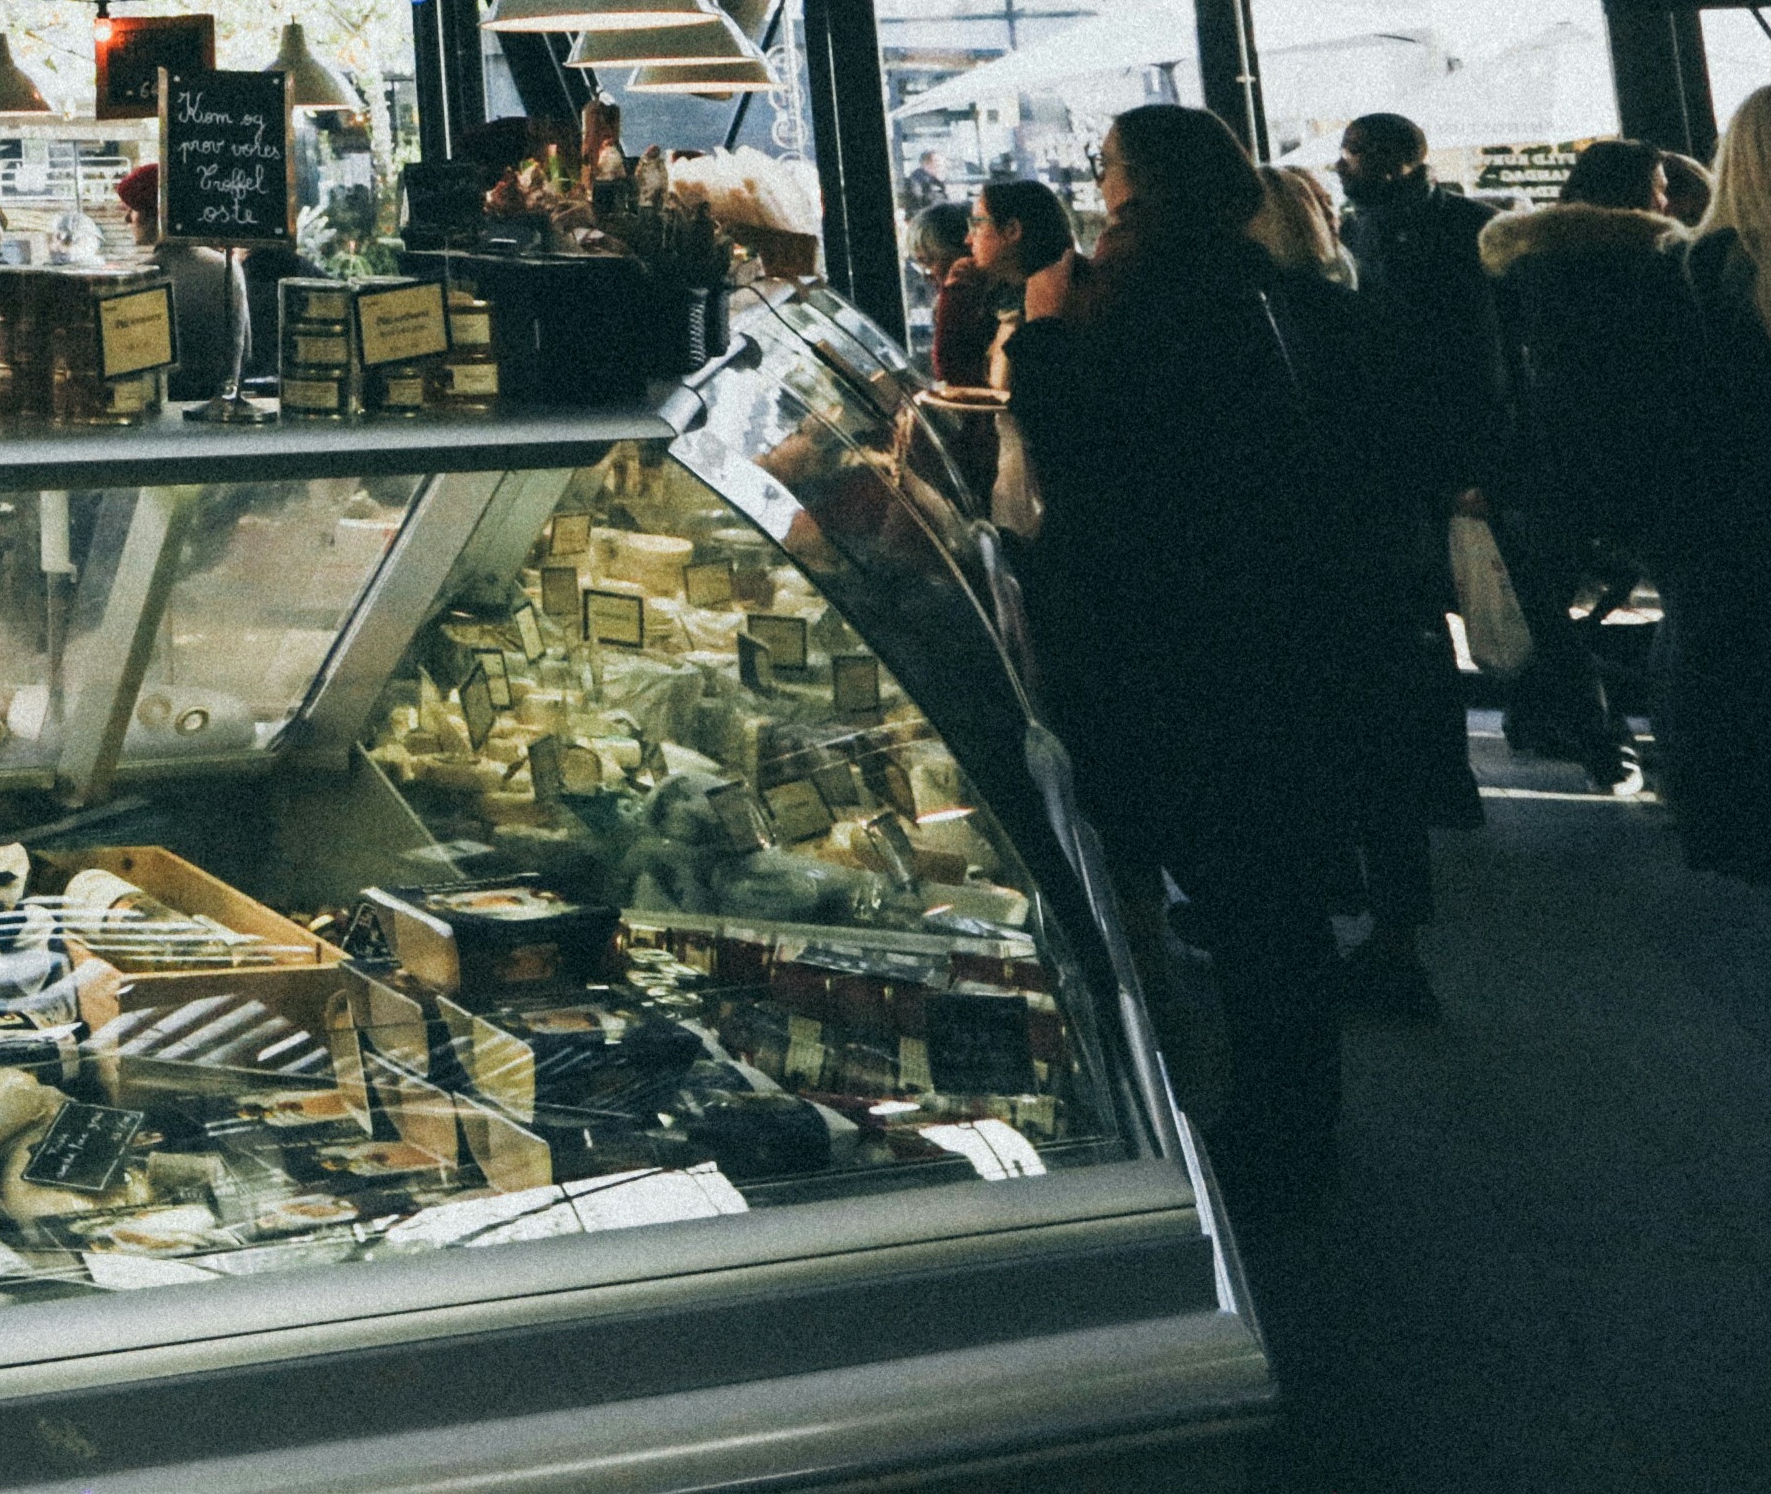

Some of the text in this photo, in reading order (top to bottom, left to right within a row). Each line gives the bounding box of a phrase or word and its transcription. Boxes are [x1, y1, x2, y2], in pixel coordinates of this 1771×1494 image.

[177, 90, 268, 148] Kom og
[198, 199, 259, 224] oste
